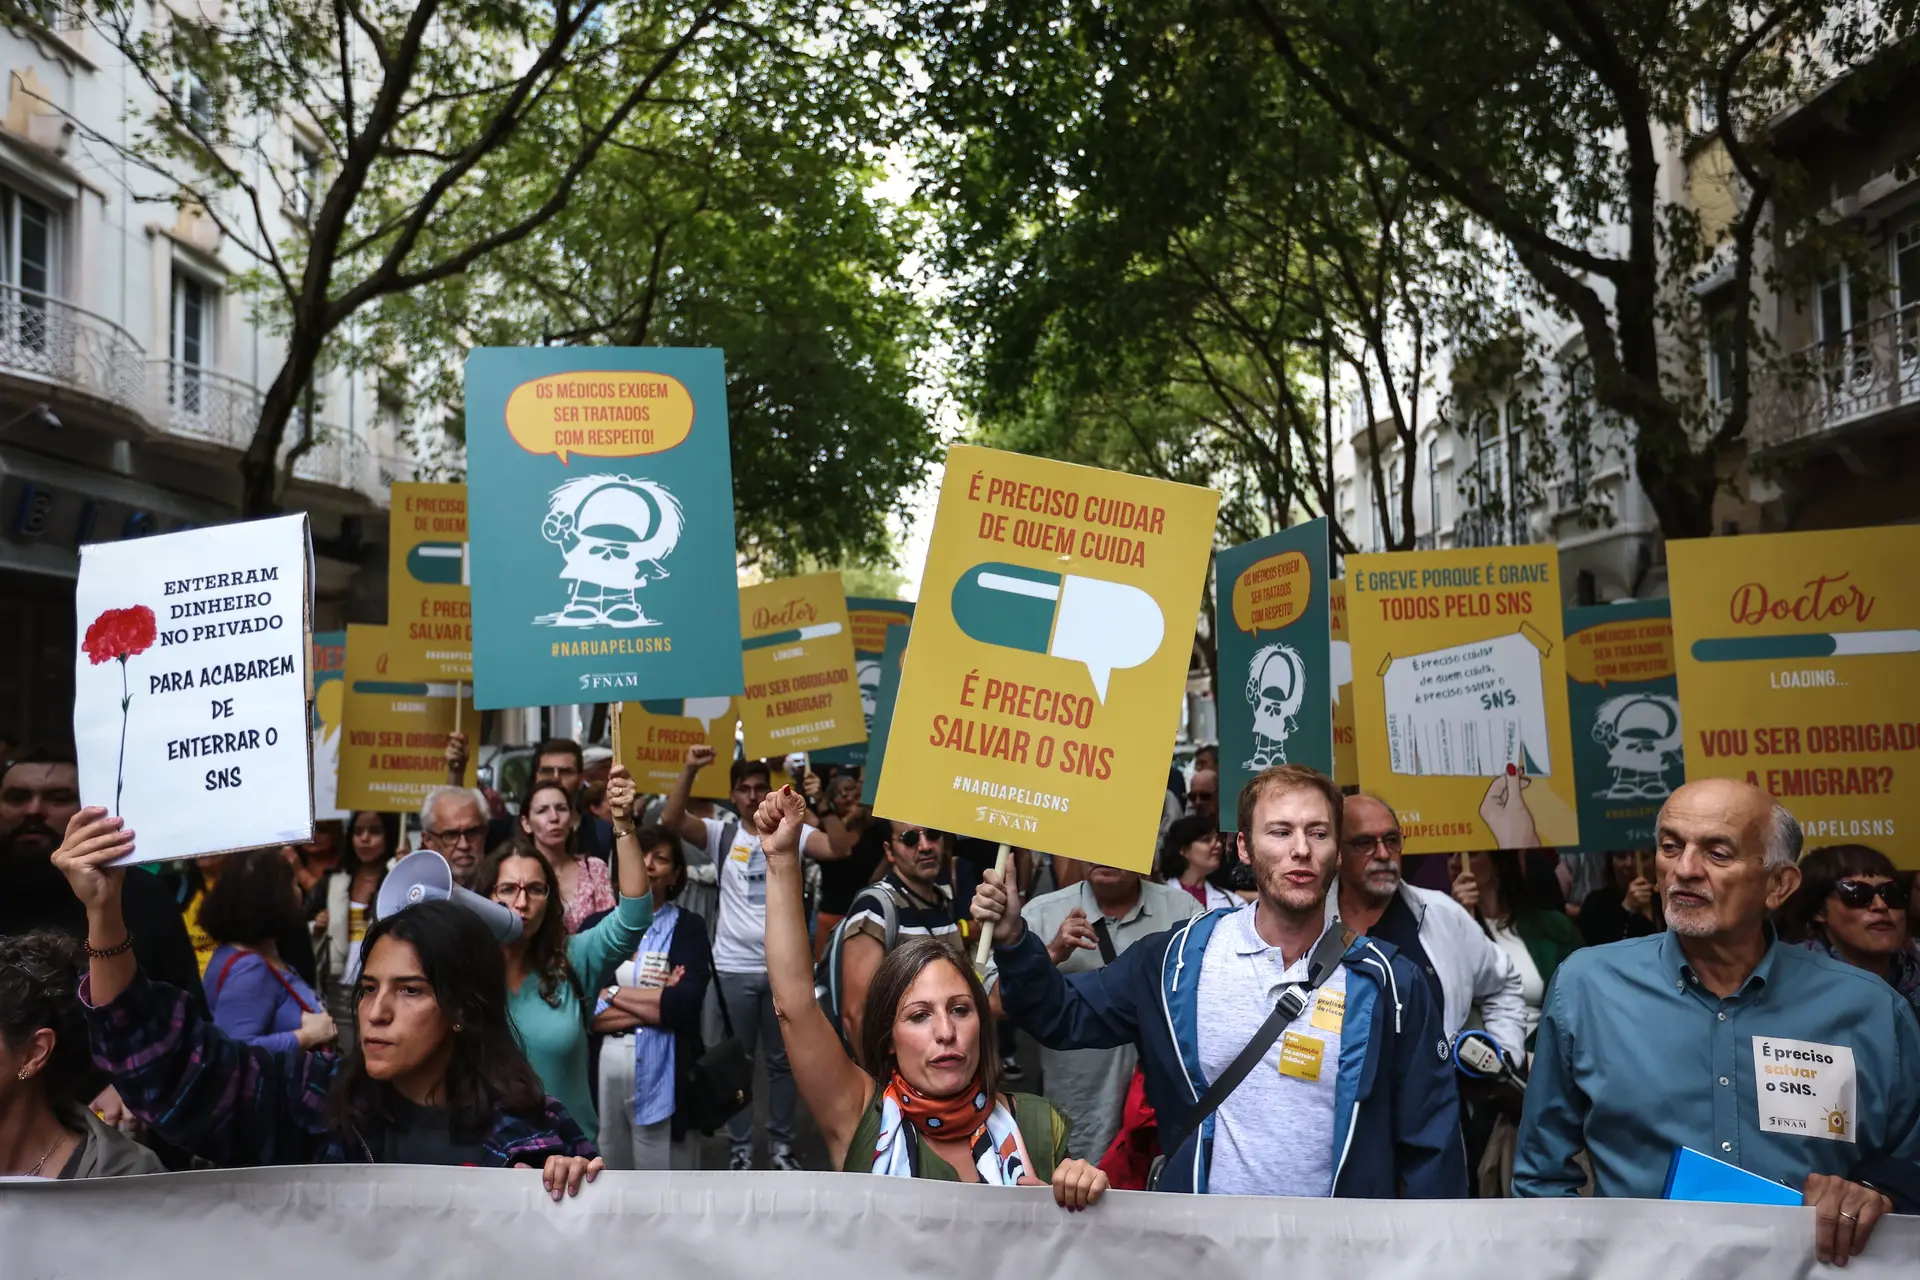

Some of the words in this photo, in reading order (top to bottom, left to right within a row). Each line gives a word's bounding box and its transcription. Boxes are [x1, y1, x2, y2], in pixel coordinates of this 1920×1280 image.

[536, 384, 552, 399] OS
[556, 380, 616, 398] MÉDICOS
[618, 383, 668, 399] EXIGEM
[554, 407, 580, 422] SER
[583, 406, 650, 422] TRATADOS
[555, 430, 584, 446] COM
[588, 428, 654, 445] RESPEITO!
[406, 494, 412, 512] É
[416, 499, 465, 514] PRECISO
[968, 470, 984, 500] É
[987, 478, 1079, 518] PRECISO
[1083, 496, 1166, 535] CUIDAR
[414, 517, 429, 531] DE
[433, 518, 466, 532] QUEM
[978, 512, 1005, 543] DE
[1012, 519, 1076, 556] QUEM
[1080, 531, 1146, 568] CUIDA
[164, 566, 280, 596] ENTERRAM
[1355, 572, 1365, 592] É
[1369, 570, 1418, 591] GREVE
[1422, 567, 1483, 589] PORQUE
[1486, 562, 1496, 586] É
[1499, 563, 1550, 584] GRAVE
[170, 591, 272, 620] DINHEIRO
[1251, 589, 1262, 604] SER
[1262, 582, 1292, 600] TRATADOS
[1730, 572, 1876, 626] Doctor
[421, 598, 430, 618] É
[752, 597, 818, 630] Doctor
[1380, 596, 1440, 622] TODOS
[1445, 593, 1492, 618] PELO
[1496, 592, 1533, 616] SNS
[160, 628, 190, 648] NO
[192, 614, 284, 642] PRIVADO
[410, 623, 462, 640] SALVAR
[551, 637, 672, 658] #NARUAPELOSNS
[1422, 654, 1461, 669] preciso
[1462, 646, 1494, 662] cuidar
[150, 668, 195, 695] PARA
[199, 654, 295, 688] ACABAREM
[744, 683, 766, 700] VOU
[768, 678, 790, 696] SER
[792, 668, 848, 692] OBRIGADO
[1420, 676, 1433, 686] de
[1770, 670, 1849, 690] LOADING...
[766, 704, 774, 718] A
[776, 693, 832, 716] EMIGRAR?
[960, 669, 979, 707] É
[983, 679, 1095, 730] PRECISO
[1424, 688, 1463, 703] preciso
[212, 698, 234, 720] DE
[167, 729, 260, 762] ENTERRAR
[265, 726, 278, 746] O
[930, 714, 1030, 765] SALVAR
[1036, 735, 1055, 769] O
[1059, 740, 1114, 782] SNS
[1699, 728, 1748, 758] VOU
[1754, 728, 1800, 756] SER
[1806, 722, 1920, 754] OBRIGAD
[204, 767, 242, 792] SNS
[1766, 766, 1894, 797] EMIGRAR?
[952, 775, 1070, 813] #NARUAPELOSNS
[1762, 1042, 1772, 1056] É
[1775, 1047, 1834, 1065] preciso
[1764, 1063, 1818, 1079] salvar
[1766, 1084, 1776, 1092] o
[1779, 1082, 1817, 1097] SNS.
